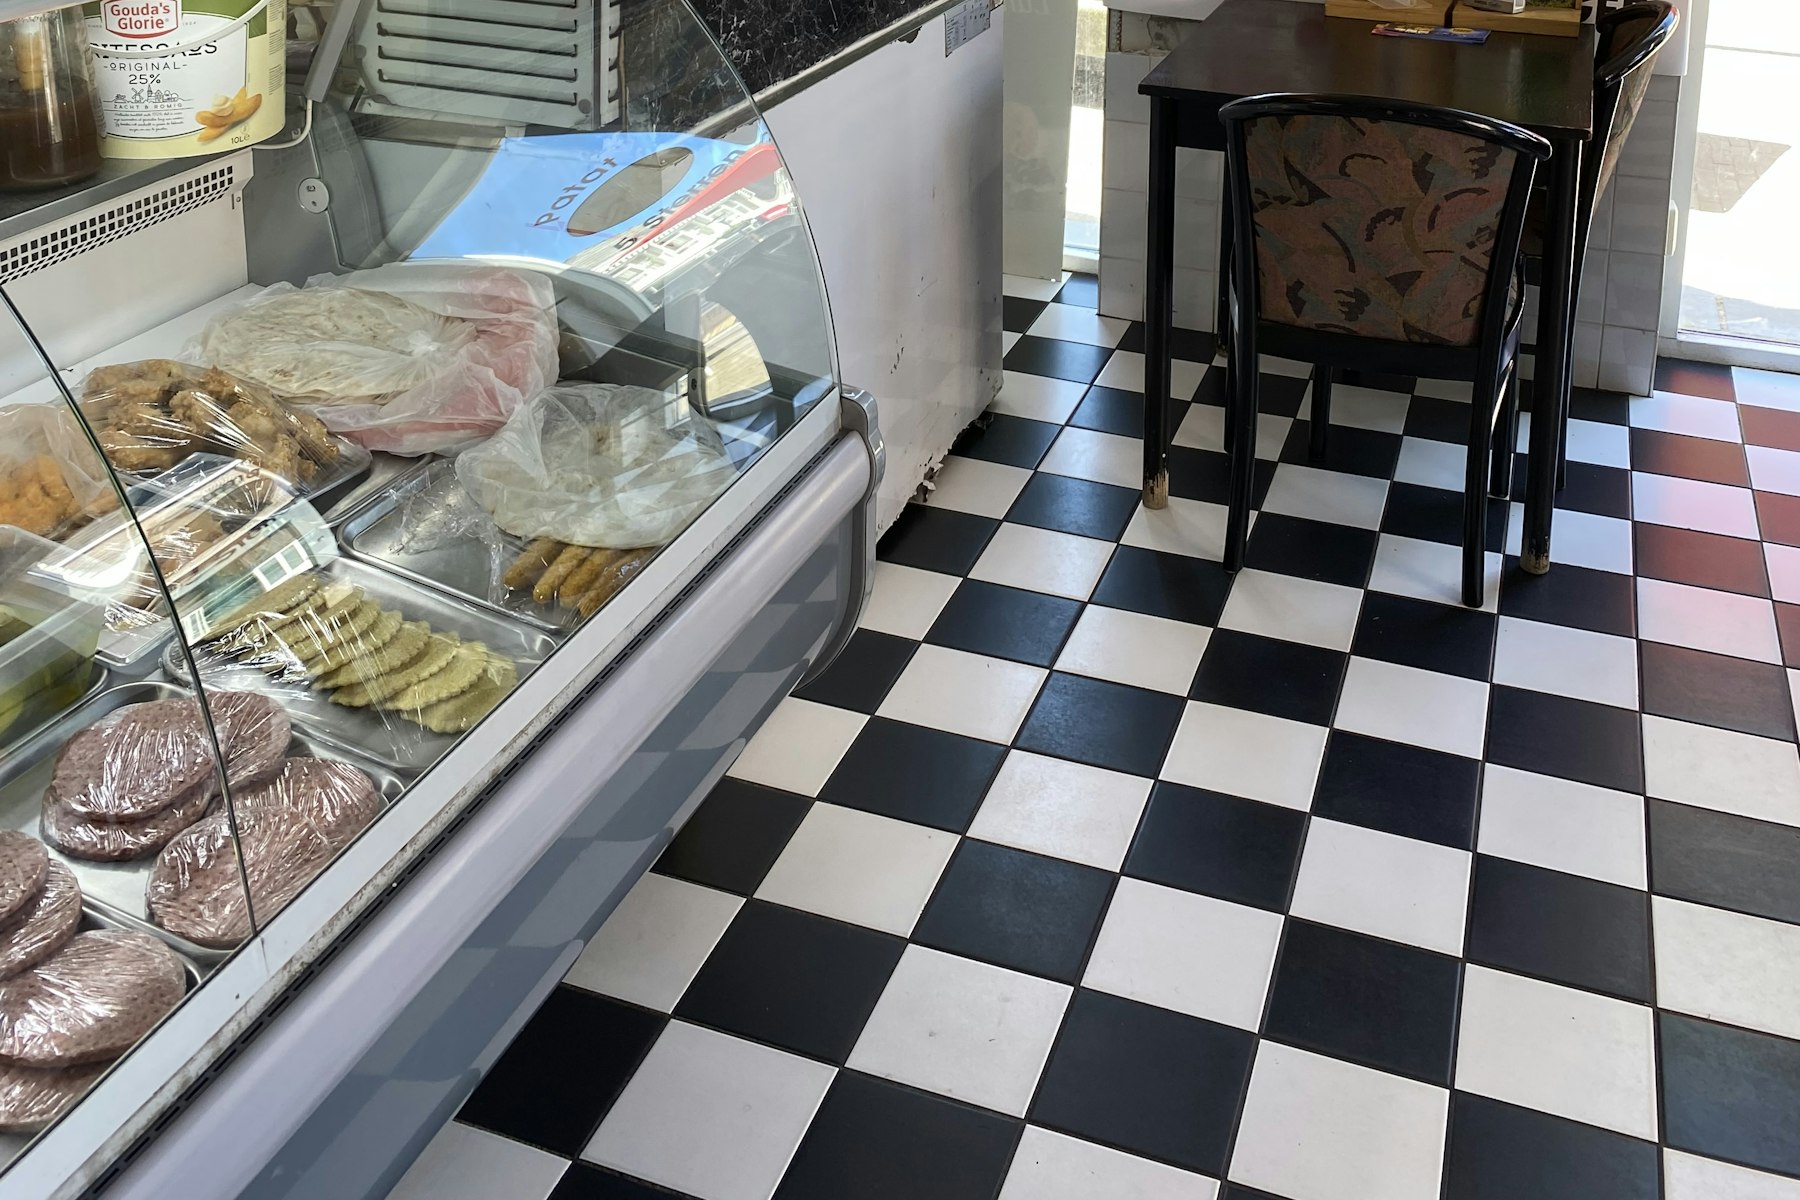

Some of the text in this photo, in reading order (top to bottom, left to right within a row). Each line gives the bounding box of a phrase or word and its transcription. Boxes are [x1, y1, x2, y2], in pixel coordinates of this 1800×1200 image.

[110, 3, 171, 16] Gouda's
[118, 15, 165, 30] Glorie
[128, 73, 161, 85] 25%
